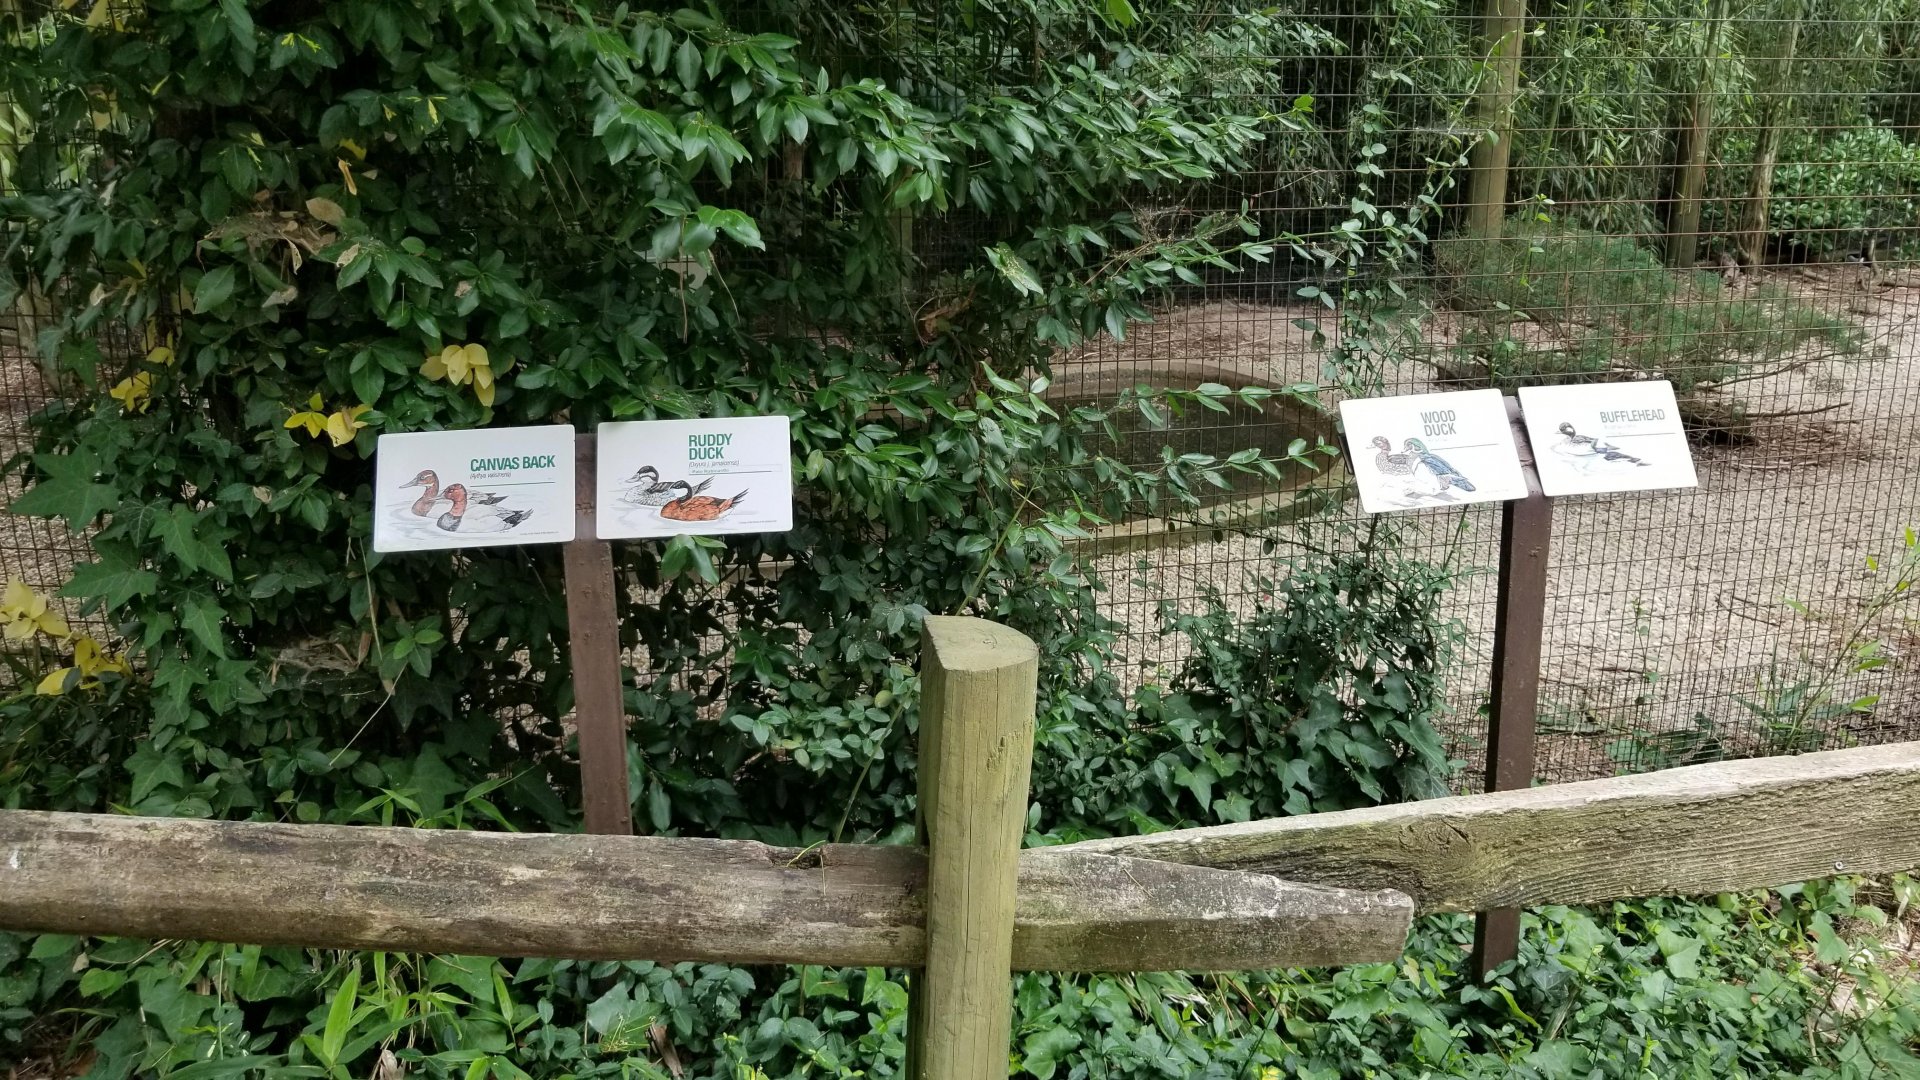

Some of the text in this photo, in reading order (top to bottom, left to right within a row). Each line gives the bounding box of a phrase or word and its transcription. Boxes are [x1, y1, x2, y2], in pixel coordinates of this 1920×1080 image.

[1420, 410, 1456, 424] WOOD
[1600, 409, 1666, 423] BUFFLEHEAD
[1424, 423, 1457, 437] DUCK
[688, 433, 733, 447] RUDDY
[688, 446, 724, 460] DUCK
[470, 455, 556, 472] CANVAS BACK
